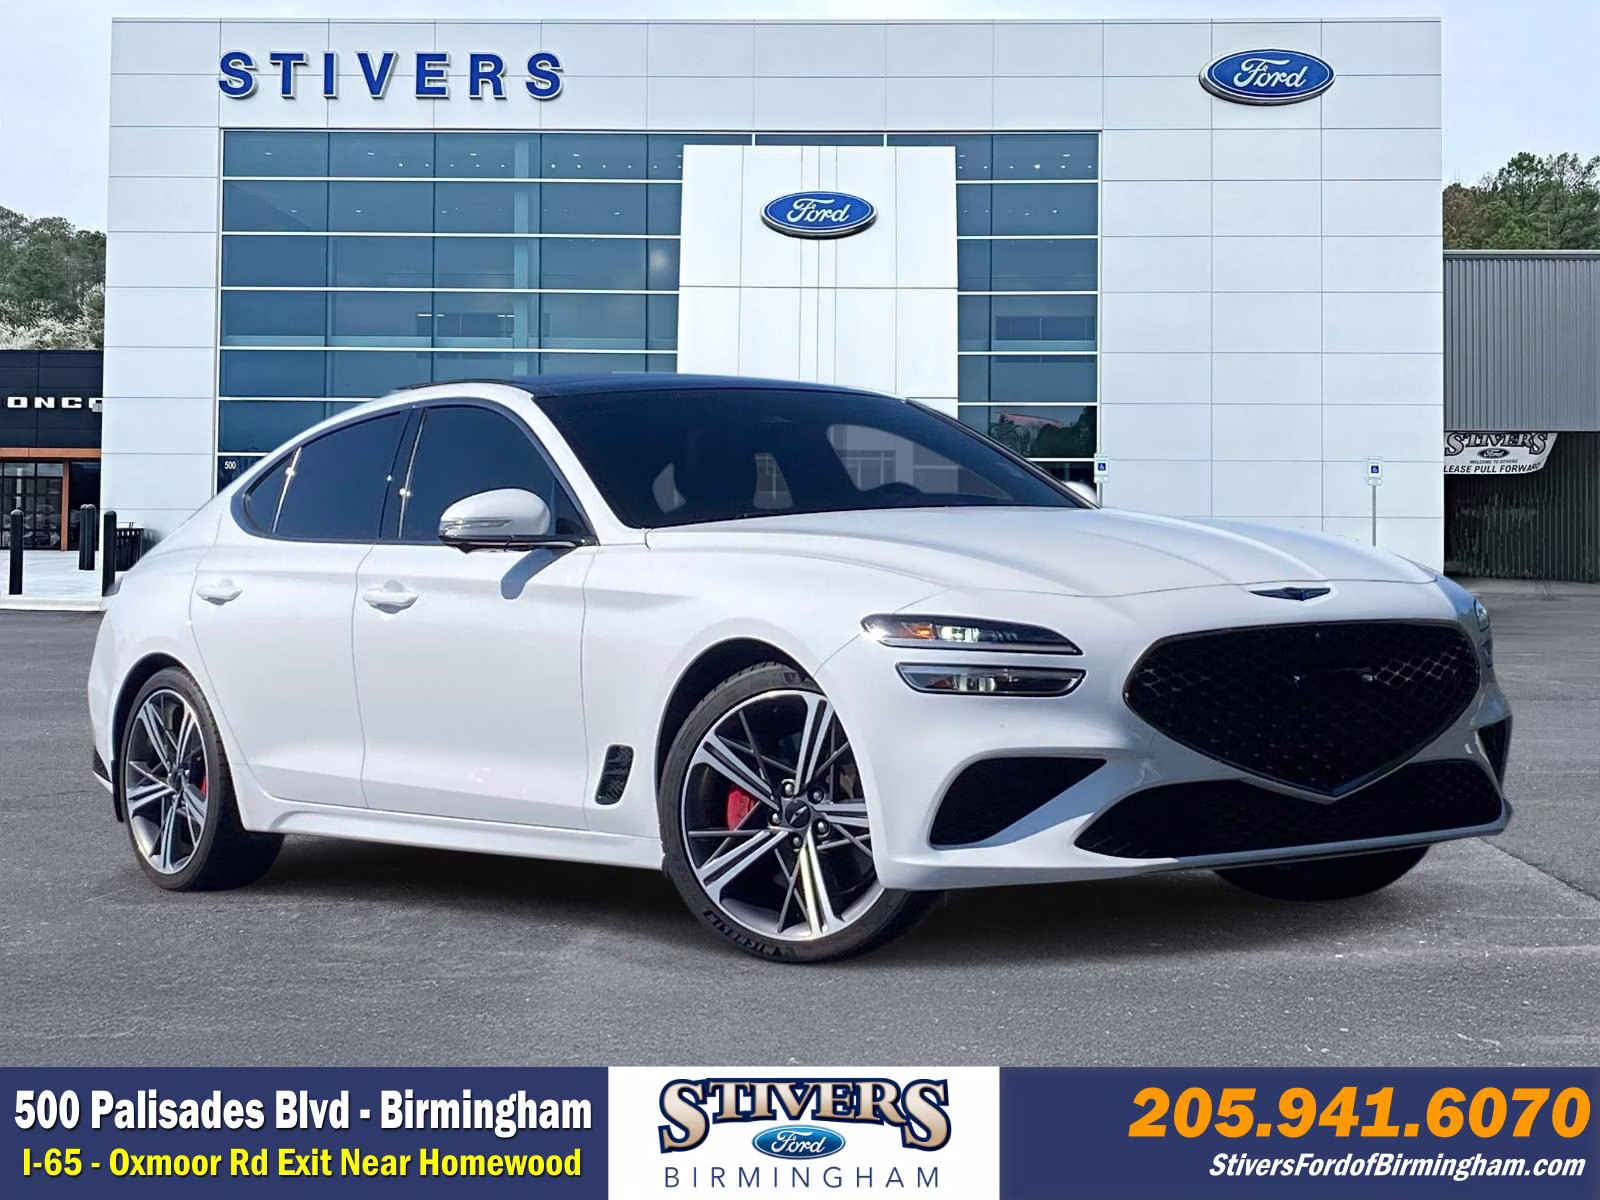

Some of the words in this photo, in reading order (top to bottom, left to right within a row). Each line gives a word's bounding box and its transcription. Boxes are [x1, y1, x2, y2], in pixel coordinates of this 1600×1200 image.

[219, 50, 563, 99] STIVERS
[1232, 57, 1309, 88] Ford
[786, 198, 852, 223] Ford
[1444, 432, 1549, 456] STIVERS
[224, 460, 237, 470] 500
[1474, 464, 1497, 473] PULL
